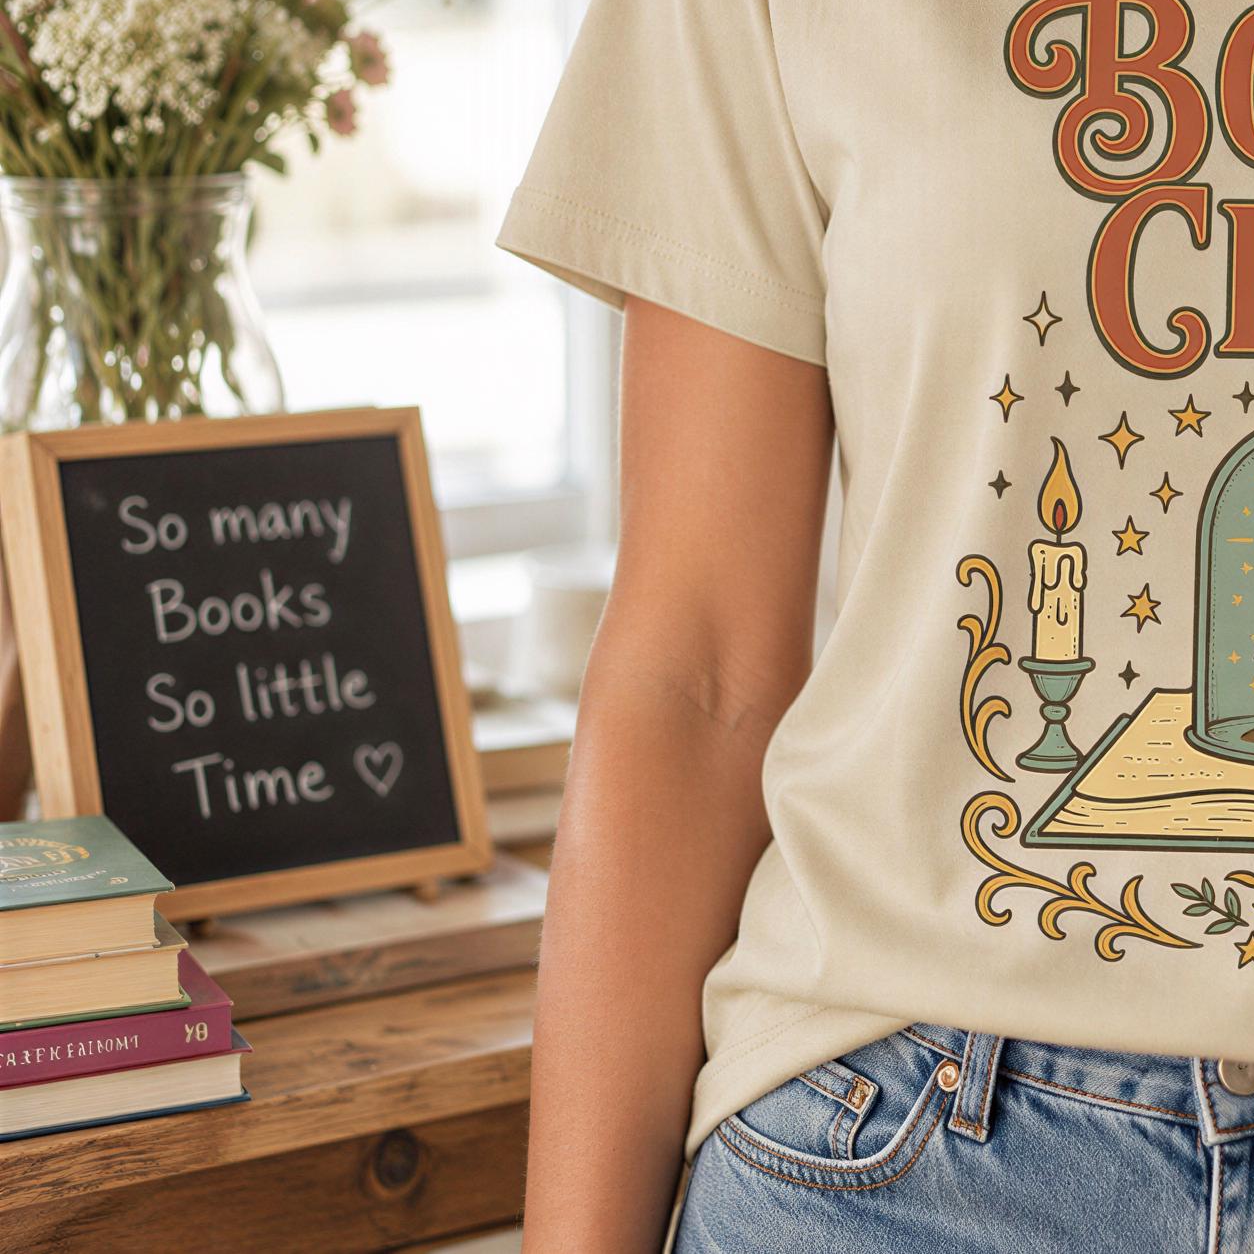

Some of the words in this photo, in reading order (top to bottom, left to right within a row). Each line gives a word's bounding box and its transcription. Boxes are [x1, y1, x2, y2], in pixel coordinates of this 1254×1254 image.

[118, 495, 188, 555] So
[209, 497, 352, 564] many
[147, 568, 332, 644] Books
[146, 672, 215, 733] So
[236, 651, 377, 722] little
[171, 752, 335, 820] Time
